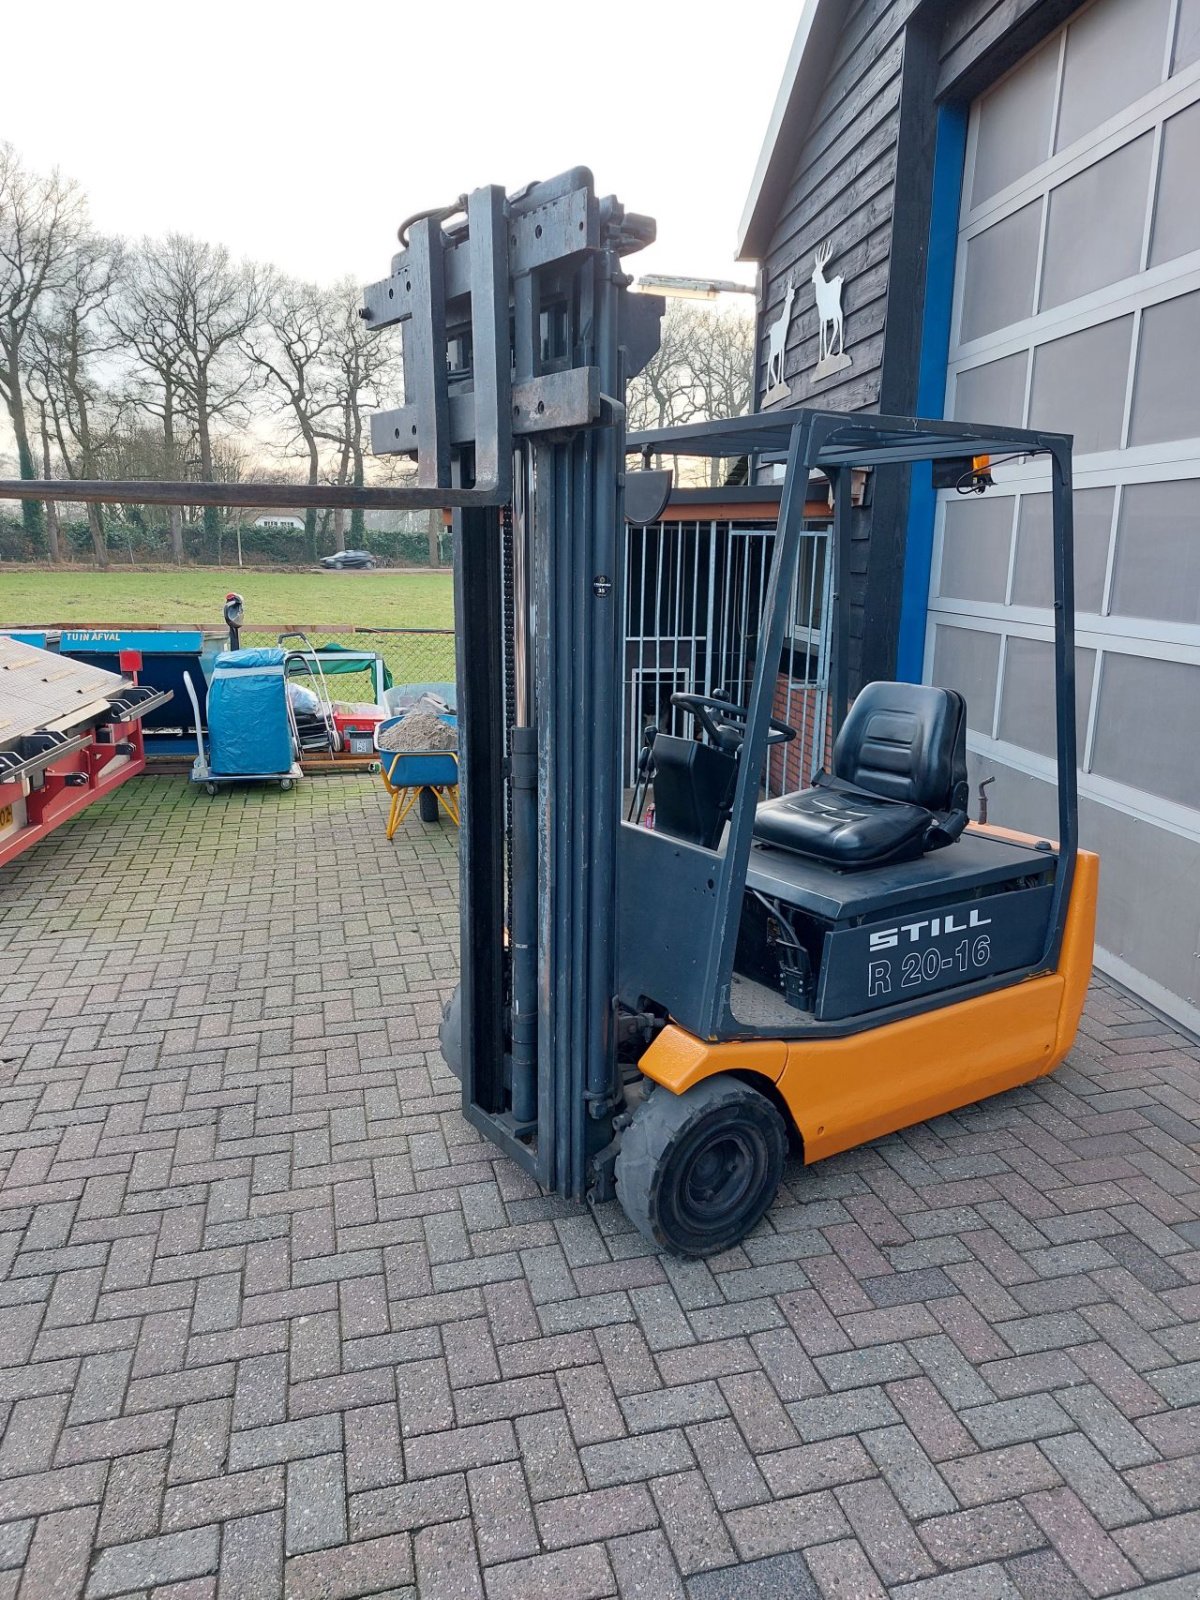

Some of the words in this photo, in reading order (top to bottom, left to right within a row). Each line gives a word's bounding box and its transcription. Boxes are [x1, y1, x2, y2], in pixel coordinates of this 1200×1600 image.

[66, 633, 89, 641] TUIN
[91, 633, 121, 641] AFVAL
[869, 909, 992, 952] STILL
[868, 959, 892, 997] R
[901, 934, 991, 988] 20-16
